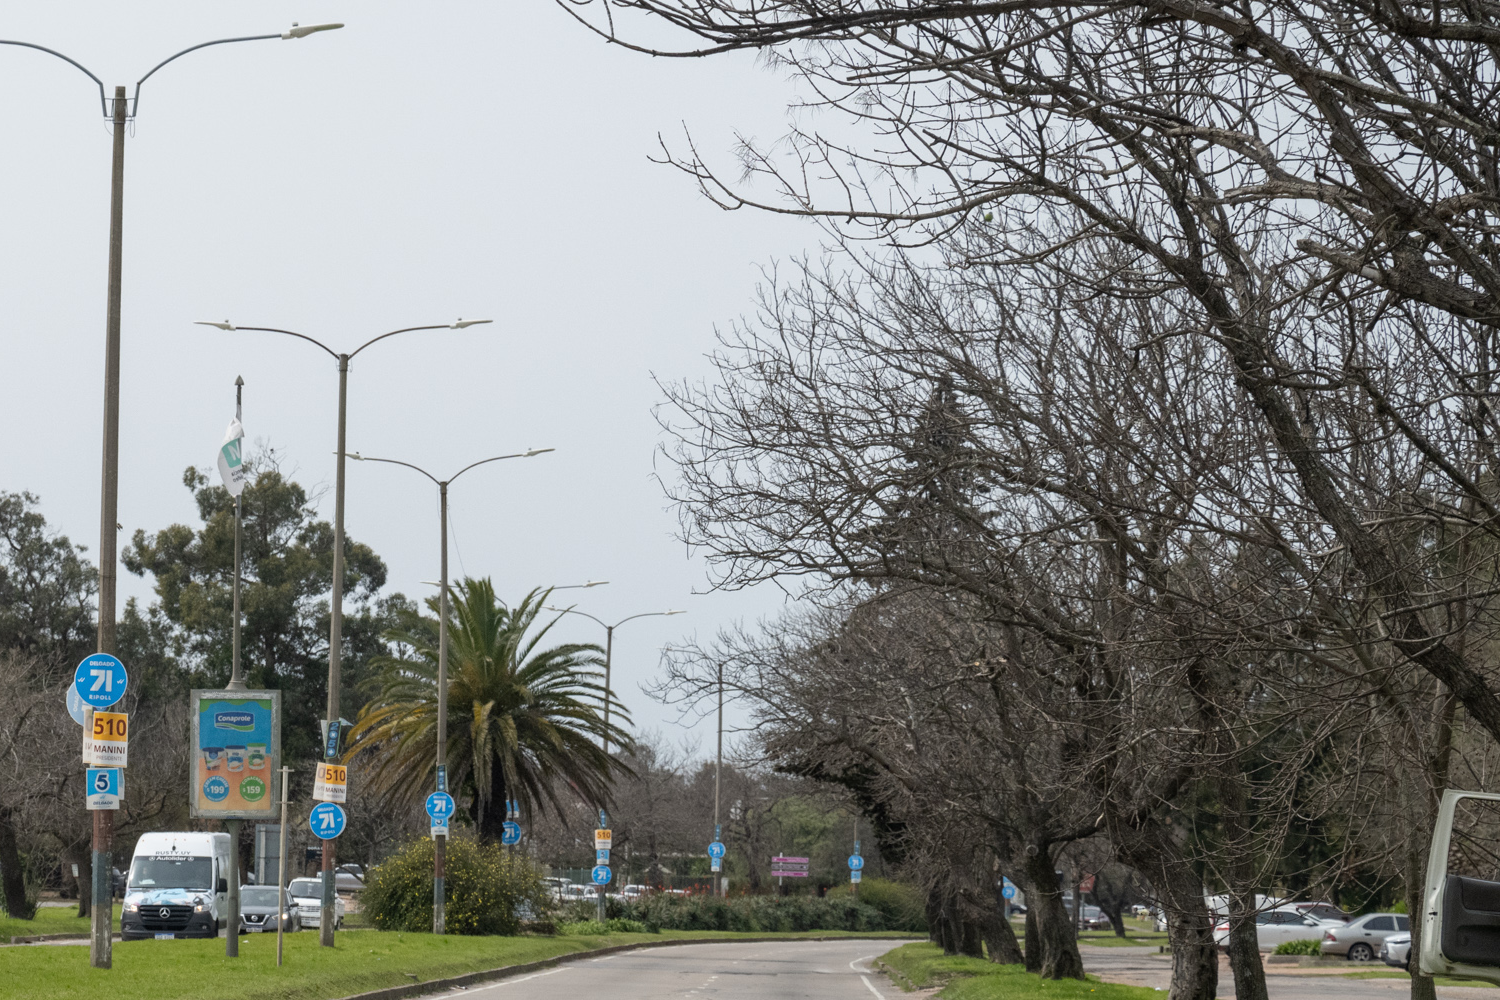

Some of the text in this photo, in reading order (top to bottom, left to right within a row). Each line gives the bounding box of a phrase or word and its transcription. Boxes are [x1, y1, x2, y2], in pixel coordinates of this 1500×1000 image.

[90, 668, 112, 692] 71
[94, 718, 126, 736] 510
[94, 744, 126, 754] MANINI
[326, 768, 346, 782] 510
[95, 773, 110, 792] 5
[211, 786, 224, 794] 199
[246, 786, 260, 794] 159
[433, 800, 446, 812] 71
[318, 812, 335, 829] 71
